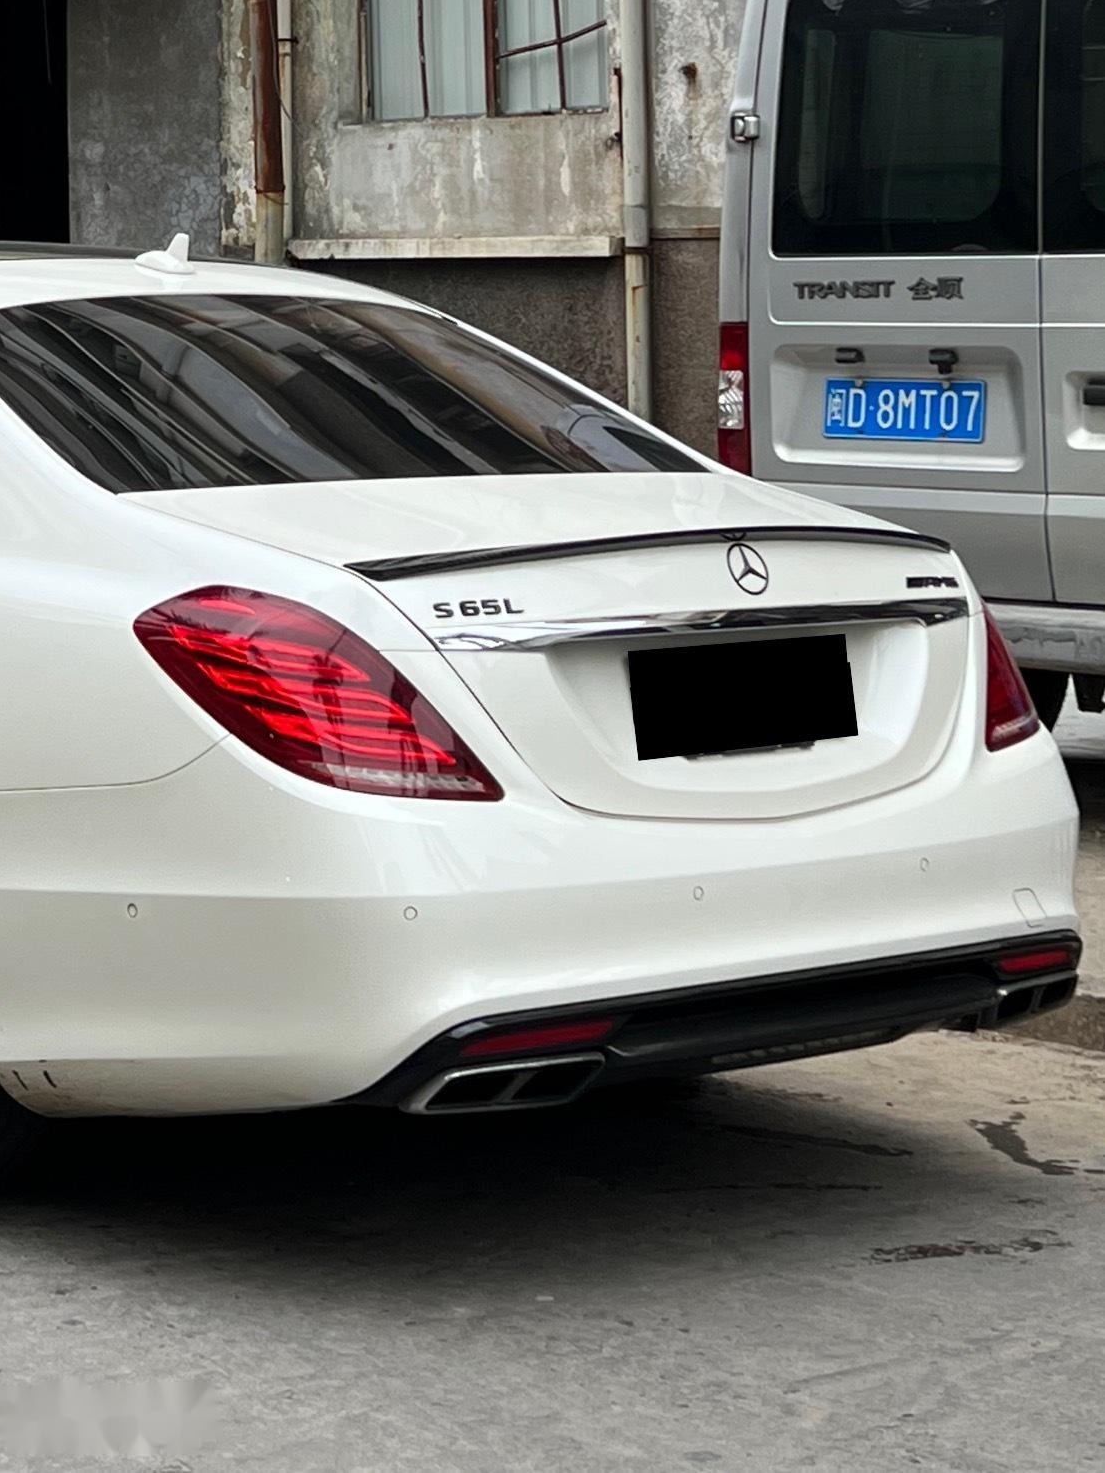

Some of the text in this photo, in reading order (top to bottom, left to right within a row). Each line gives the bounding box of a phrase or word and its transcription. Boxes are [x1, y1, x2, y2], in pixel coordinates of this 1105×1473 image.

[793, 276, 964, 300] TRANSIT 全顺
[433, 598, 525, 618] S 65L
